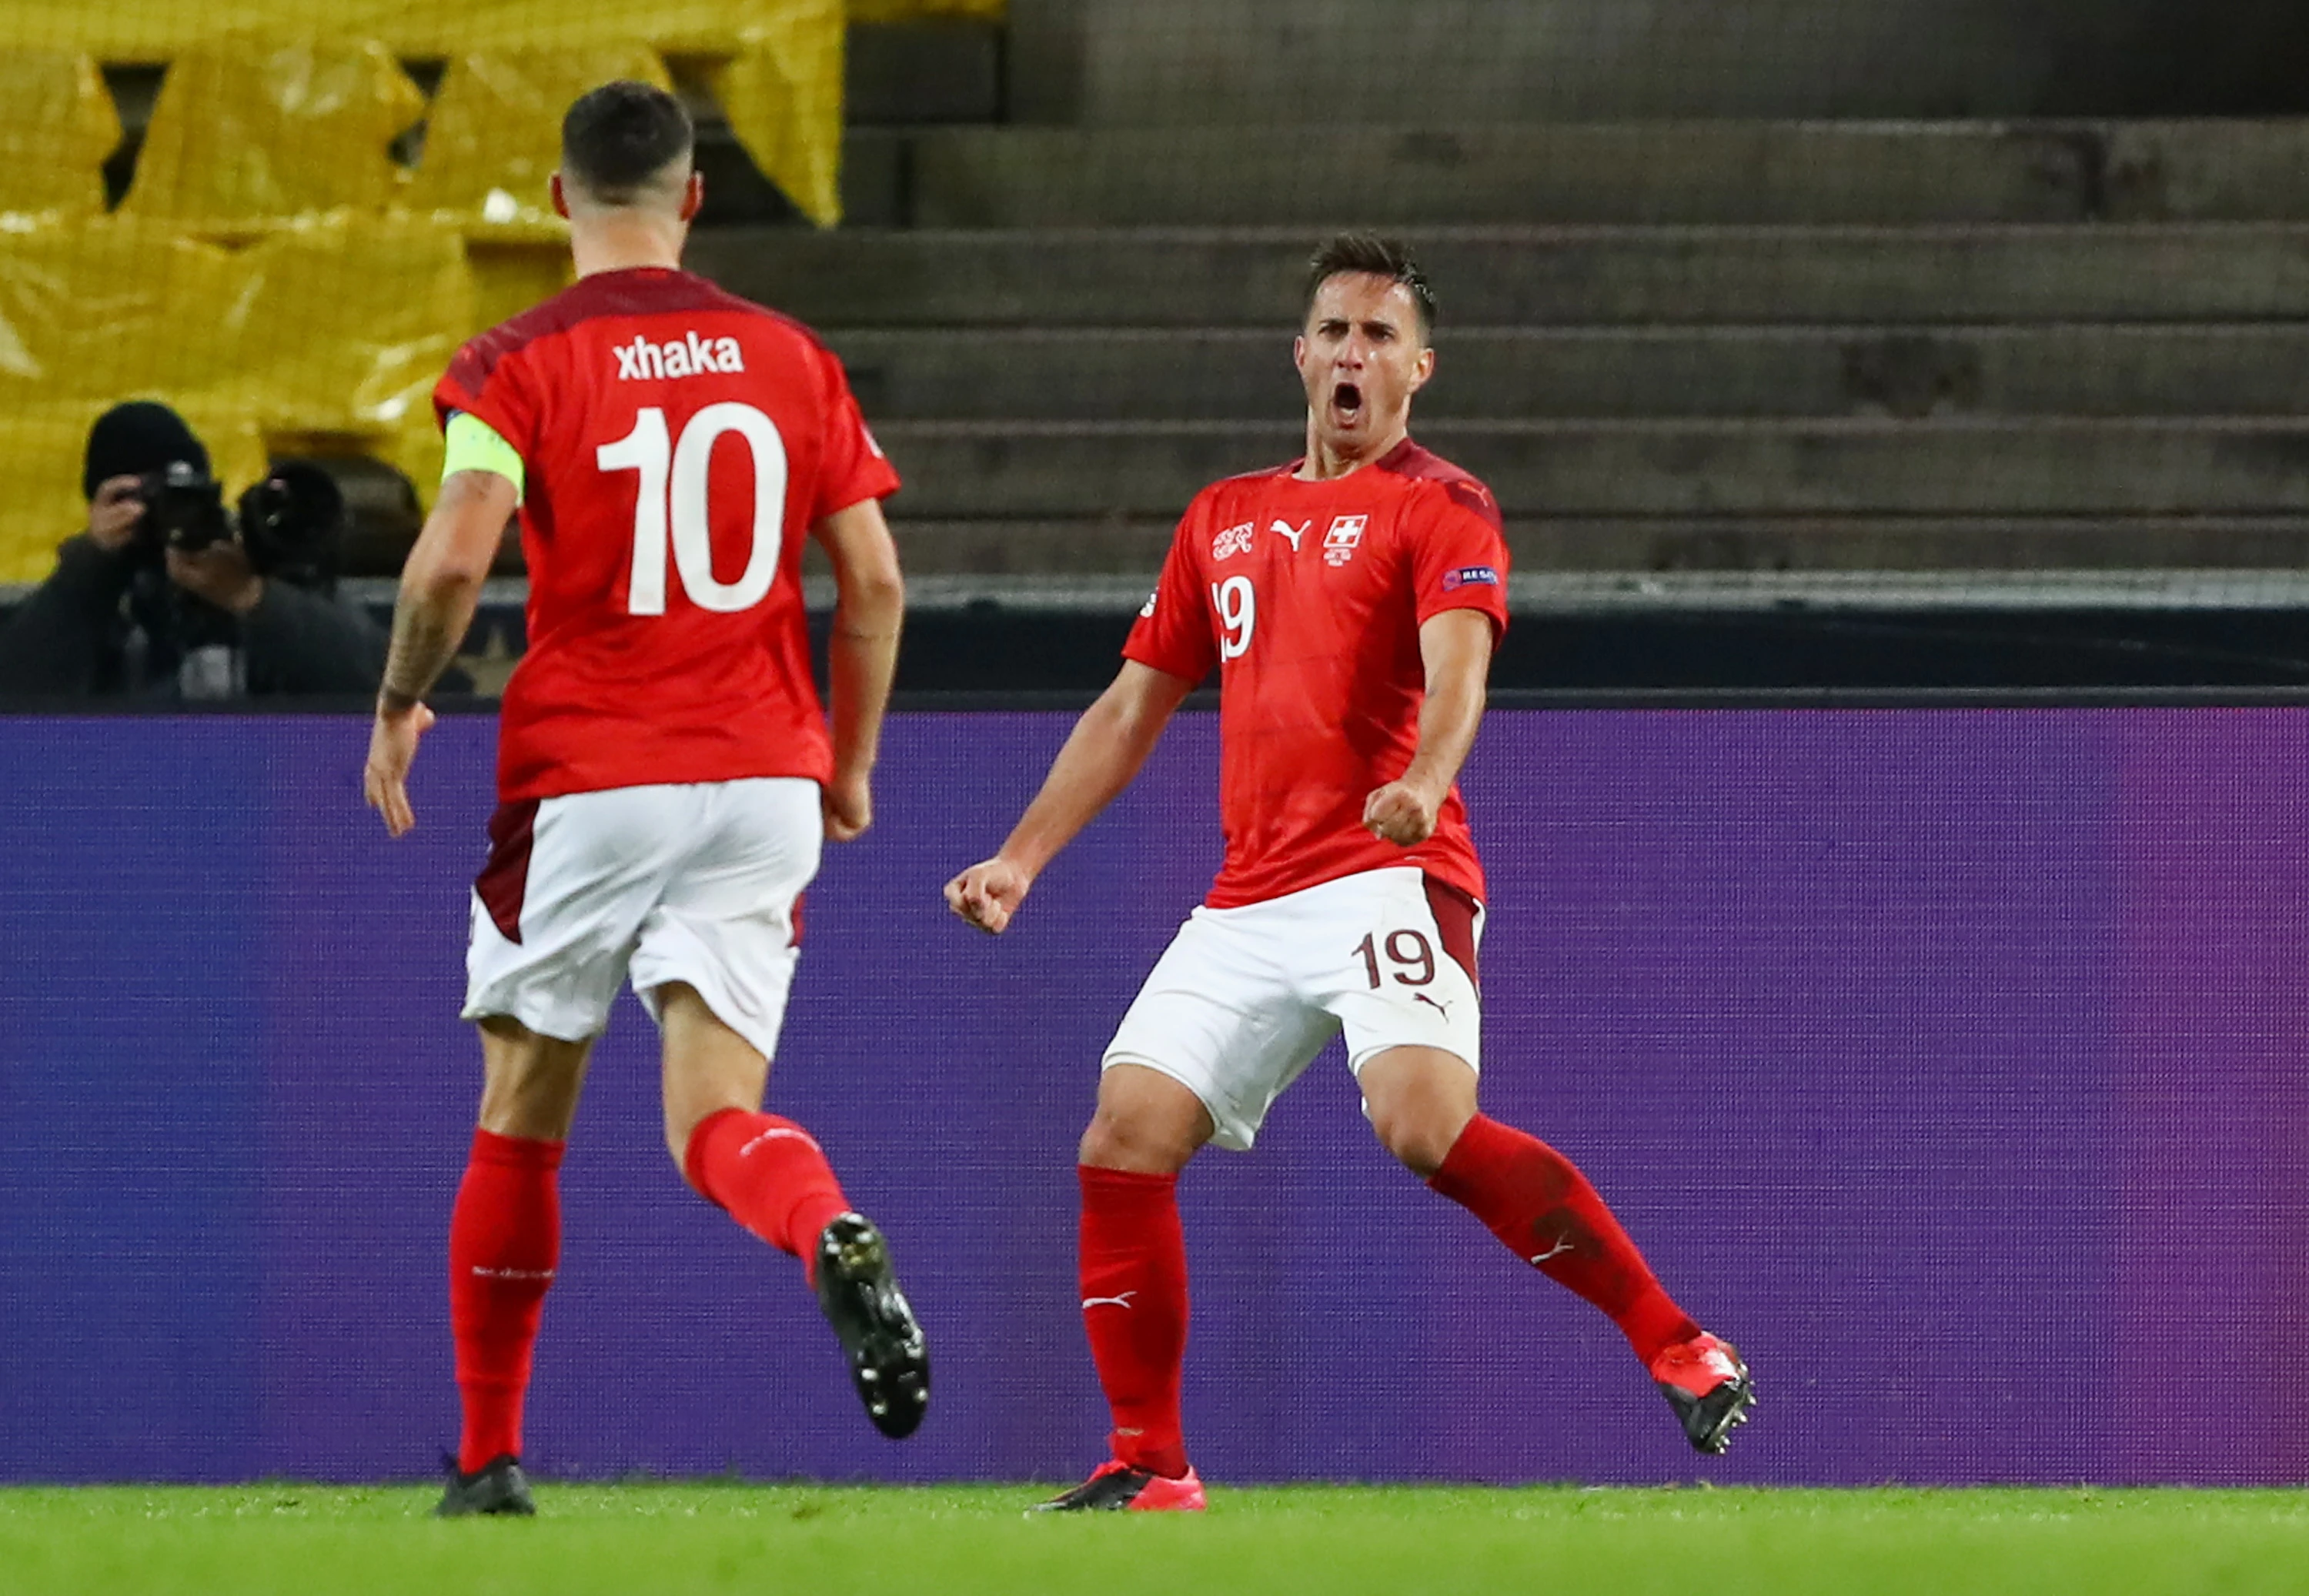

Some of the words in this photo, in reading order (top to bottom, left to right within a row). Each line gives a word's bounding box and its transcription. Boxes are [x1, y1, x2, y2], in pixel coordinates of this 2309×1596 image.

[613, 331, 744, 379] xhaka
[596, 402, 787, 615] 10
[1351, 929, 1435, 989] 19
